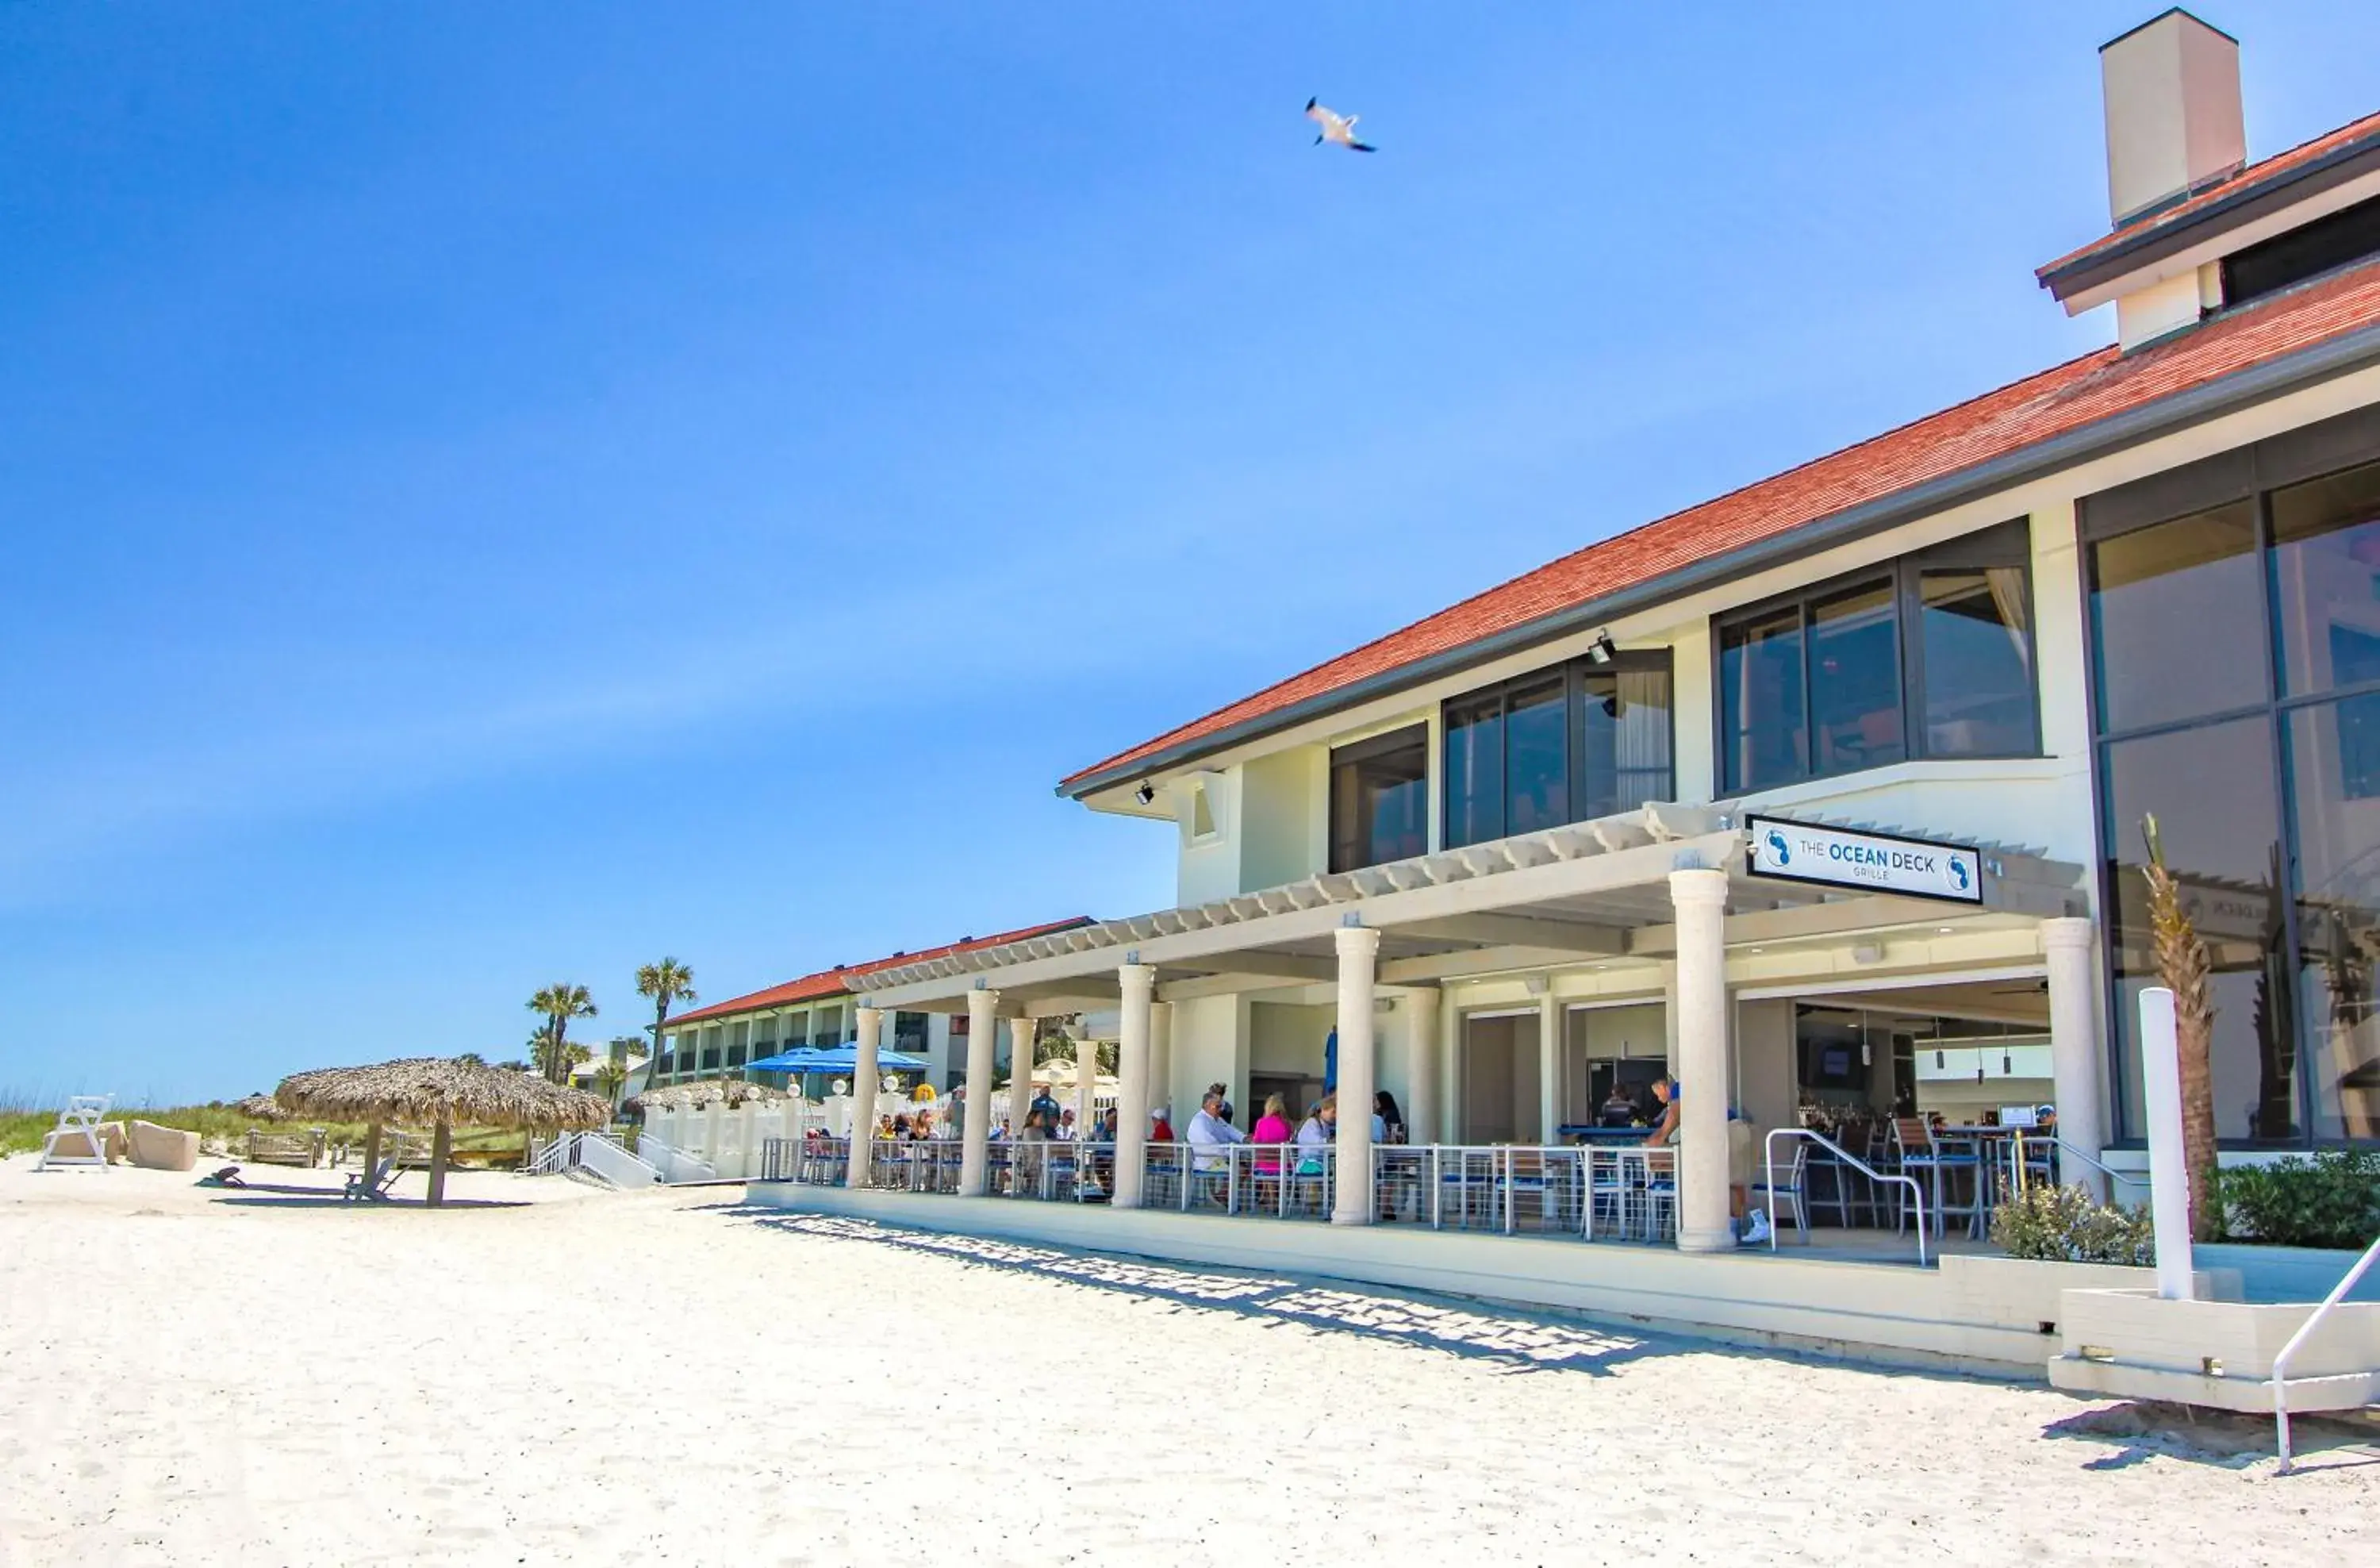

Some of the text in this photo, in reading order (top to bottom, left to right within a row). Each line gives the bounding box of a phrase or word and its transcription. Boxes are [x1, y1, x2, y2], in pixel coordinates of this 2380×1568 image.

[1800, 841, 1935, 873] THE OCEAN DECK
[1854, 867, 1889, 881] GRILLE
